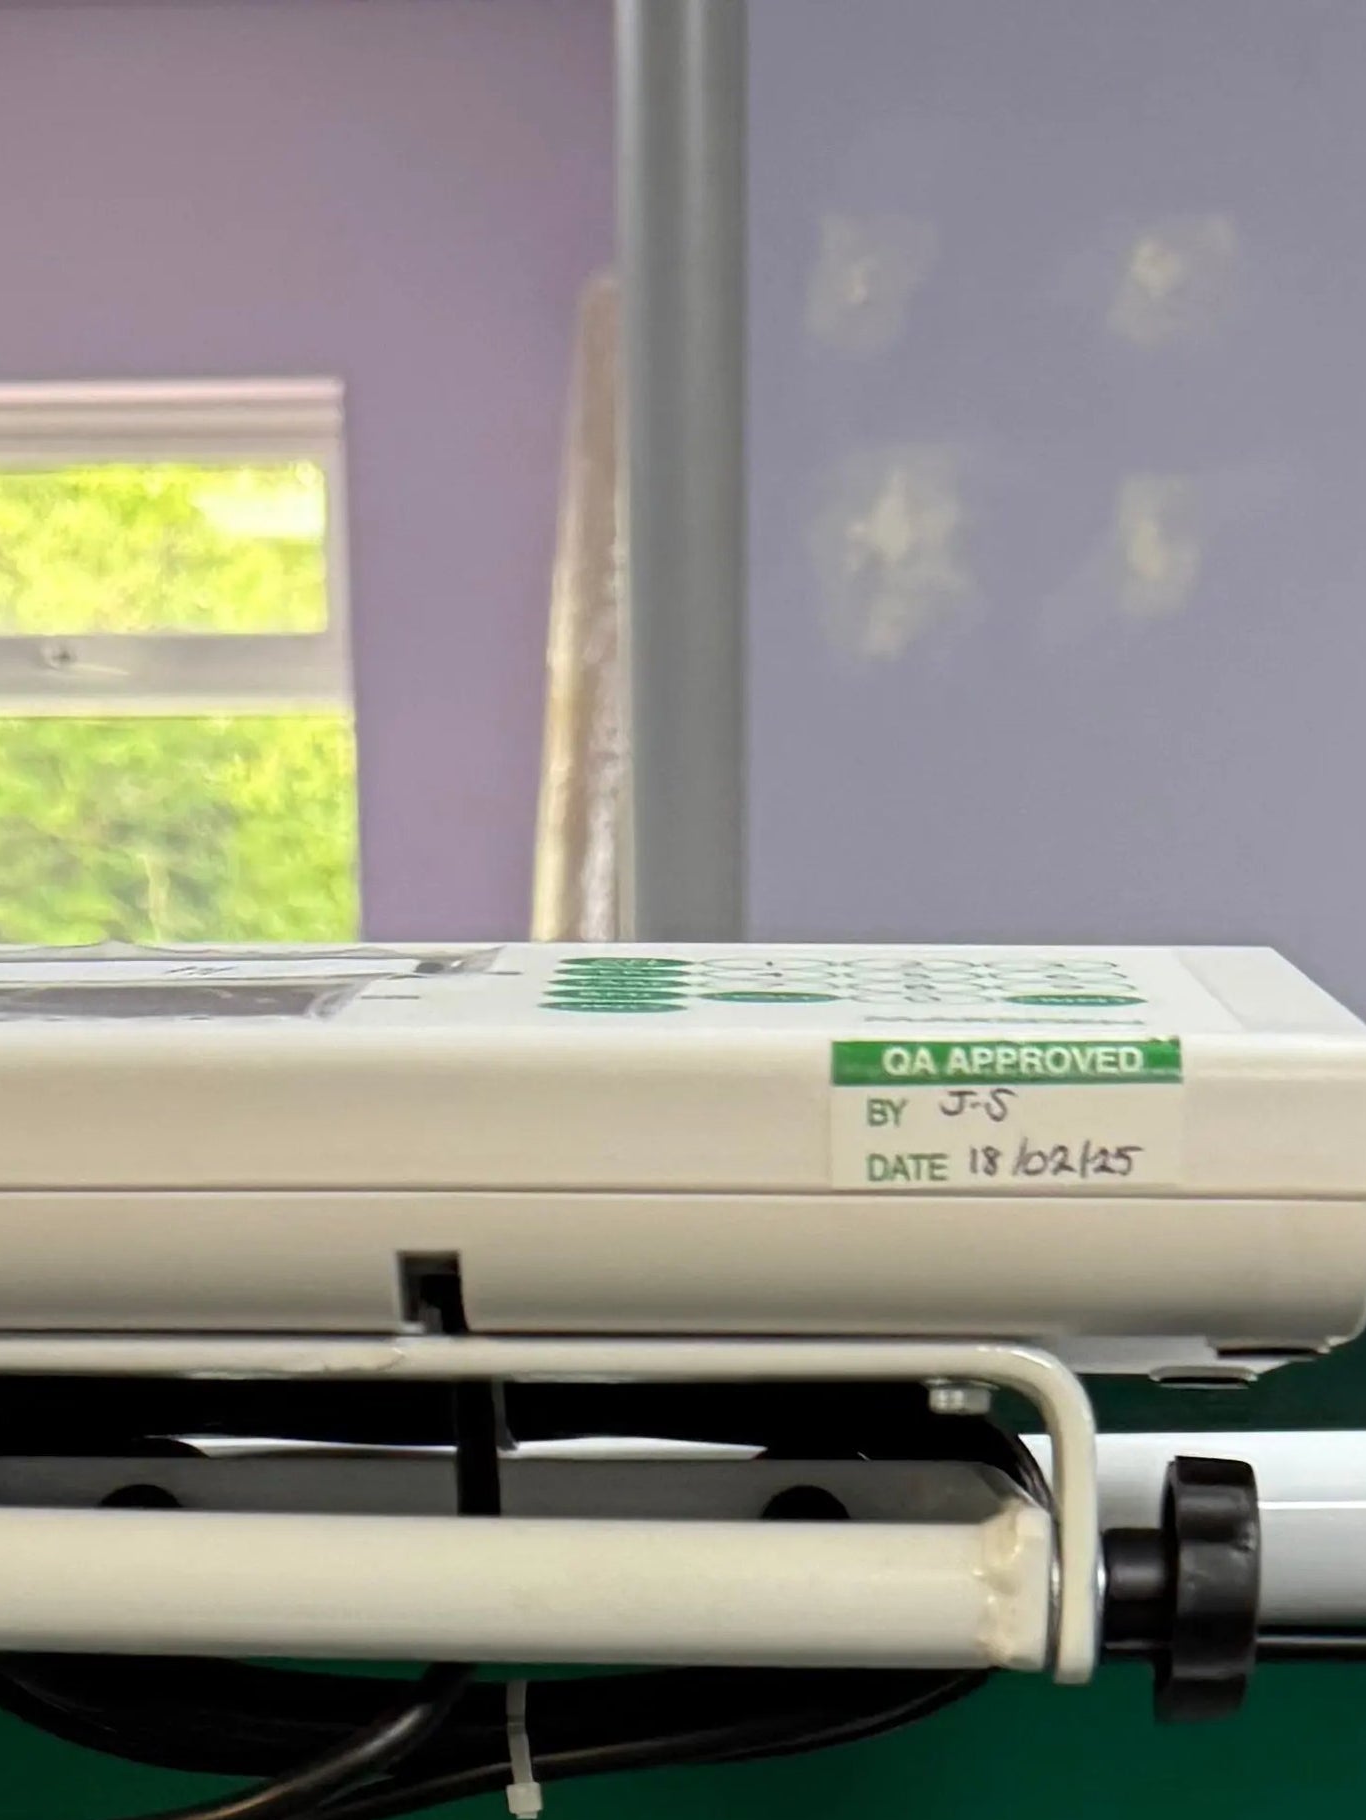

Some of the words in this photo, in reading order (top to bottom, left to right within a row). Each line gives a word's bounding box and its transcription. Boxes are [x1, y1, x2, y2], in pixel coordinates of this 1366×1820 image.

[882, 1047, 937, 1076] QA
[947, 1046, 1144, 1075] APPROVED
[867, 1098, 909, 1127] BY
[867, 1153, 949, 1181] DATE
